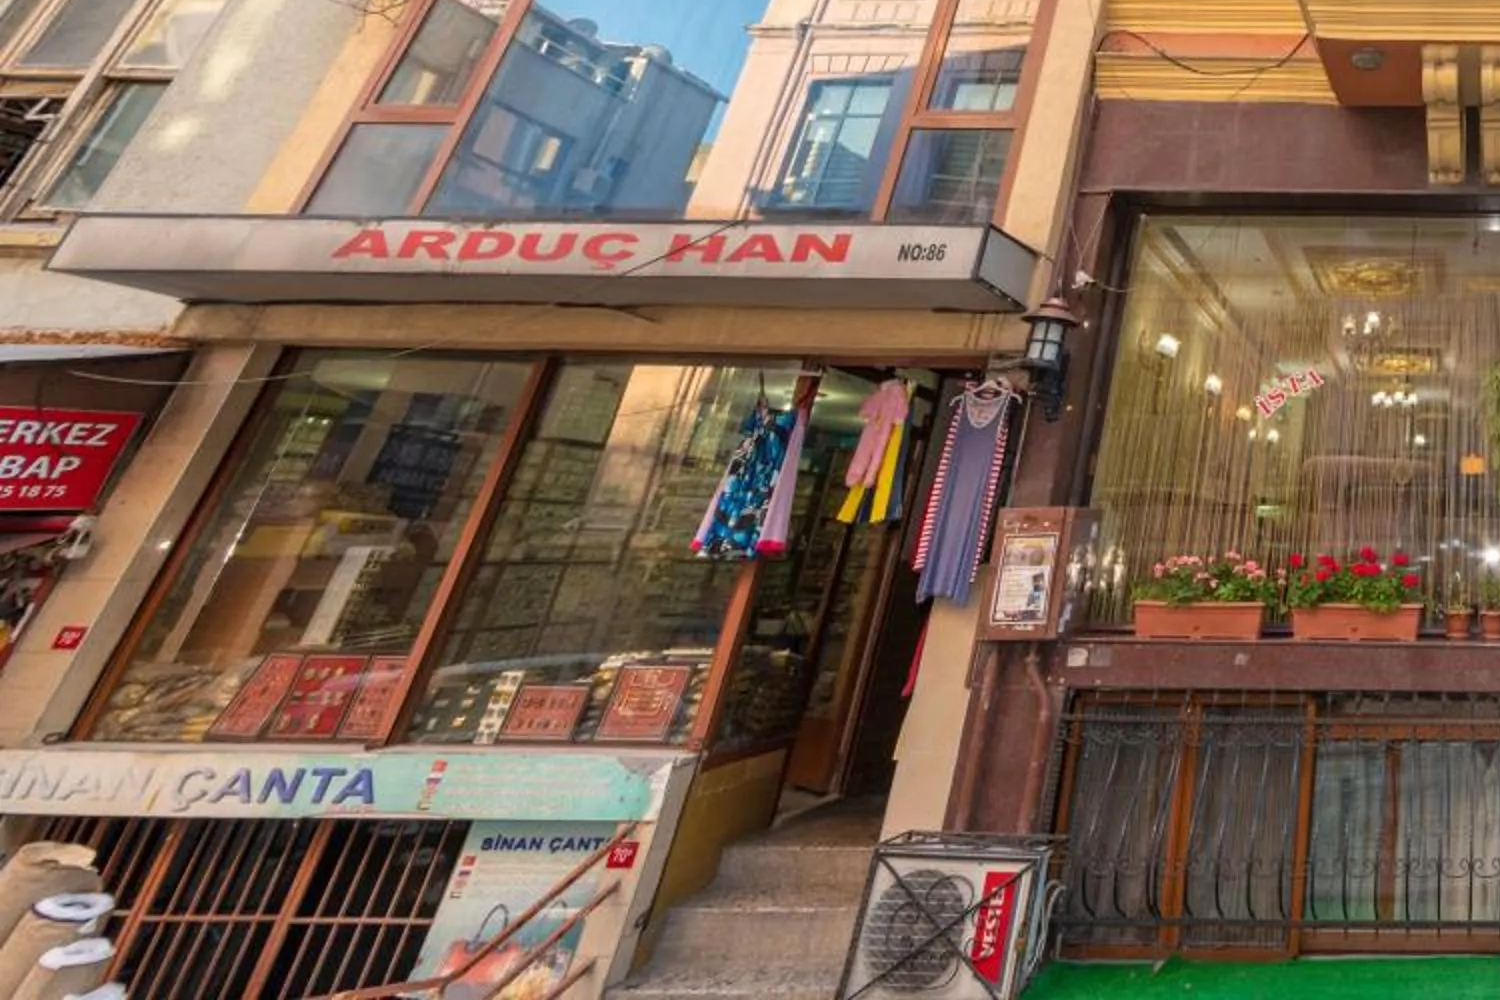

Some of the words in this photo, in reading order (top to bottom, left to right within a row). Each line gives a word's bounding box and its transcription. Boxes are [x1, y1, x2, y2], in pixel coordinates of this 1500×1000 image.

[330, 229, 641, 269] ARDUÇ
[665, 233, 853, 264] HAN
[898, 244, 948, 262] NO:86
[0, 761, 156, 801] İNAN
[171, 767, 376, 813] ÇANTA
[480, 834, 544, 851] SİNAN
[548, 837, 612, 854] ÇANT
